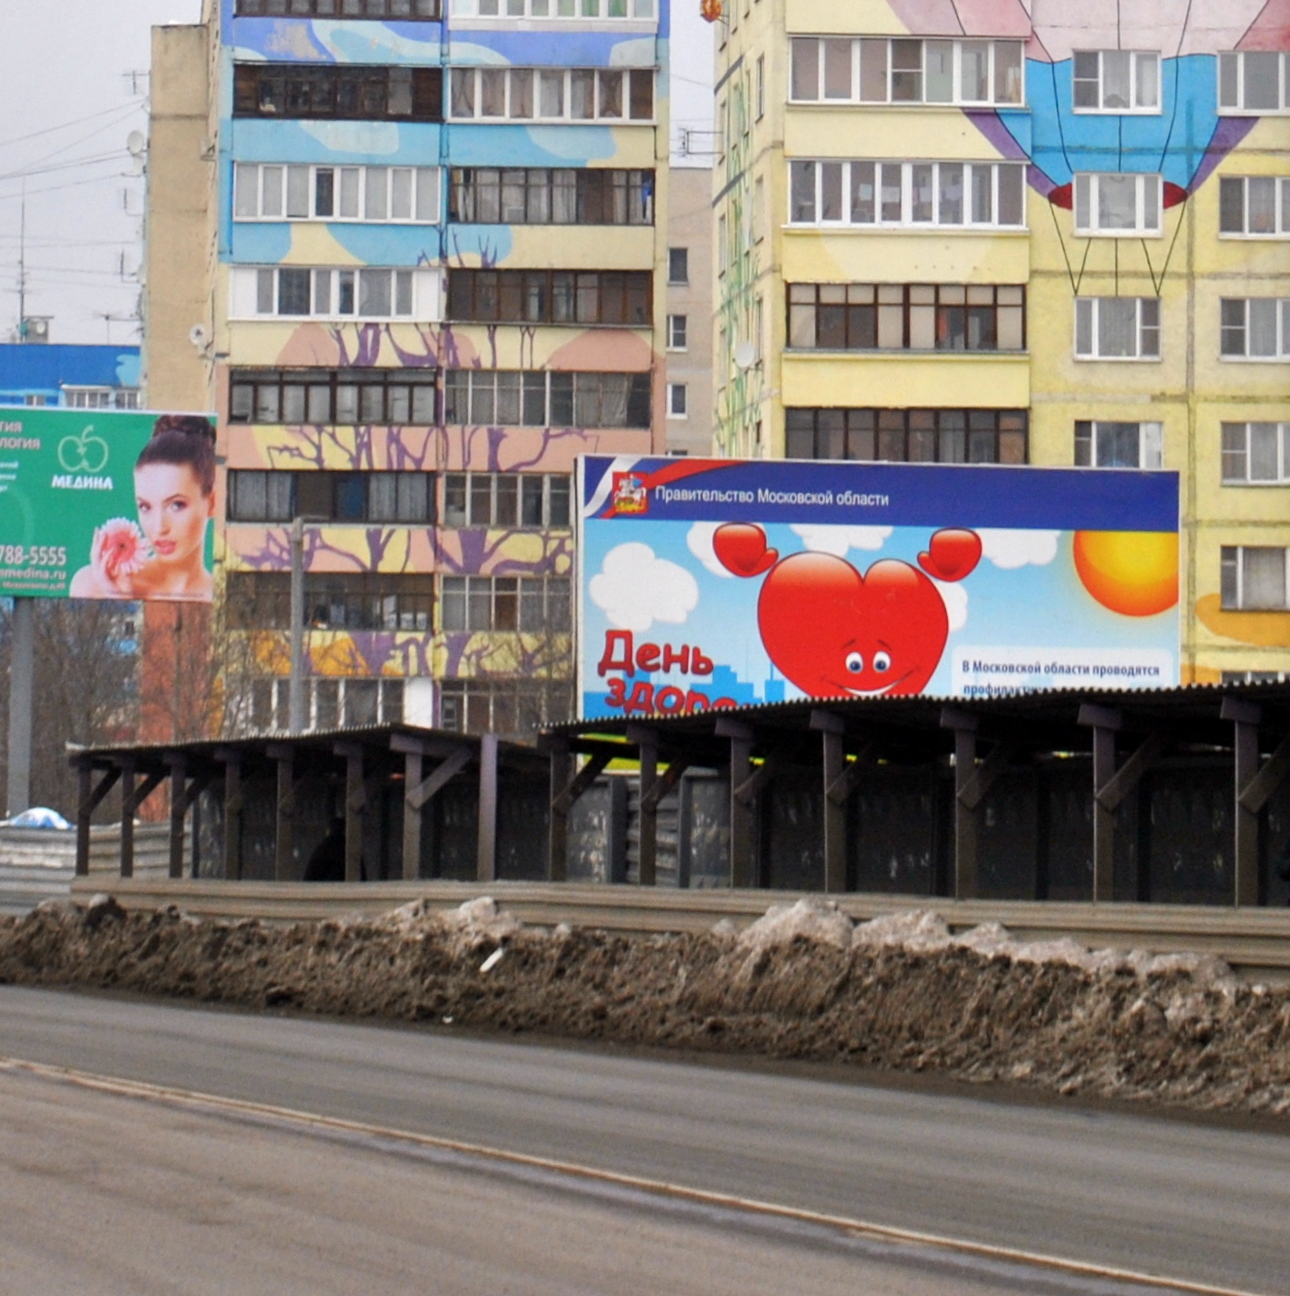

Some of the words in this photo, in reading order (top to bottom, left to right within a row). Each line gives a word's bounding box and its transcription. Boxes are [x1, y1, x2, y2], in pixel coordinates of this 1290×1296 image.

[51, 473, 114, 491] МЕДИНА
[655, 485, 755, 504] Правительство
[757, 488, 834, 505] Московской
[836, 490, 890, 507] области
[597, 629, 714, 678] День
[961, 660, 970, 672] В
[972, 661, 1041, 674] Московской
[1043, 662, 1090, 675] области
[1092, 664, 1160, 678] проводятся
